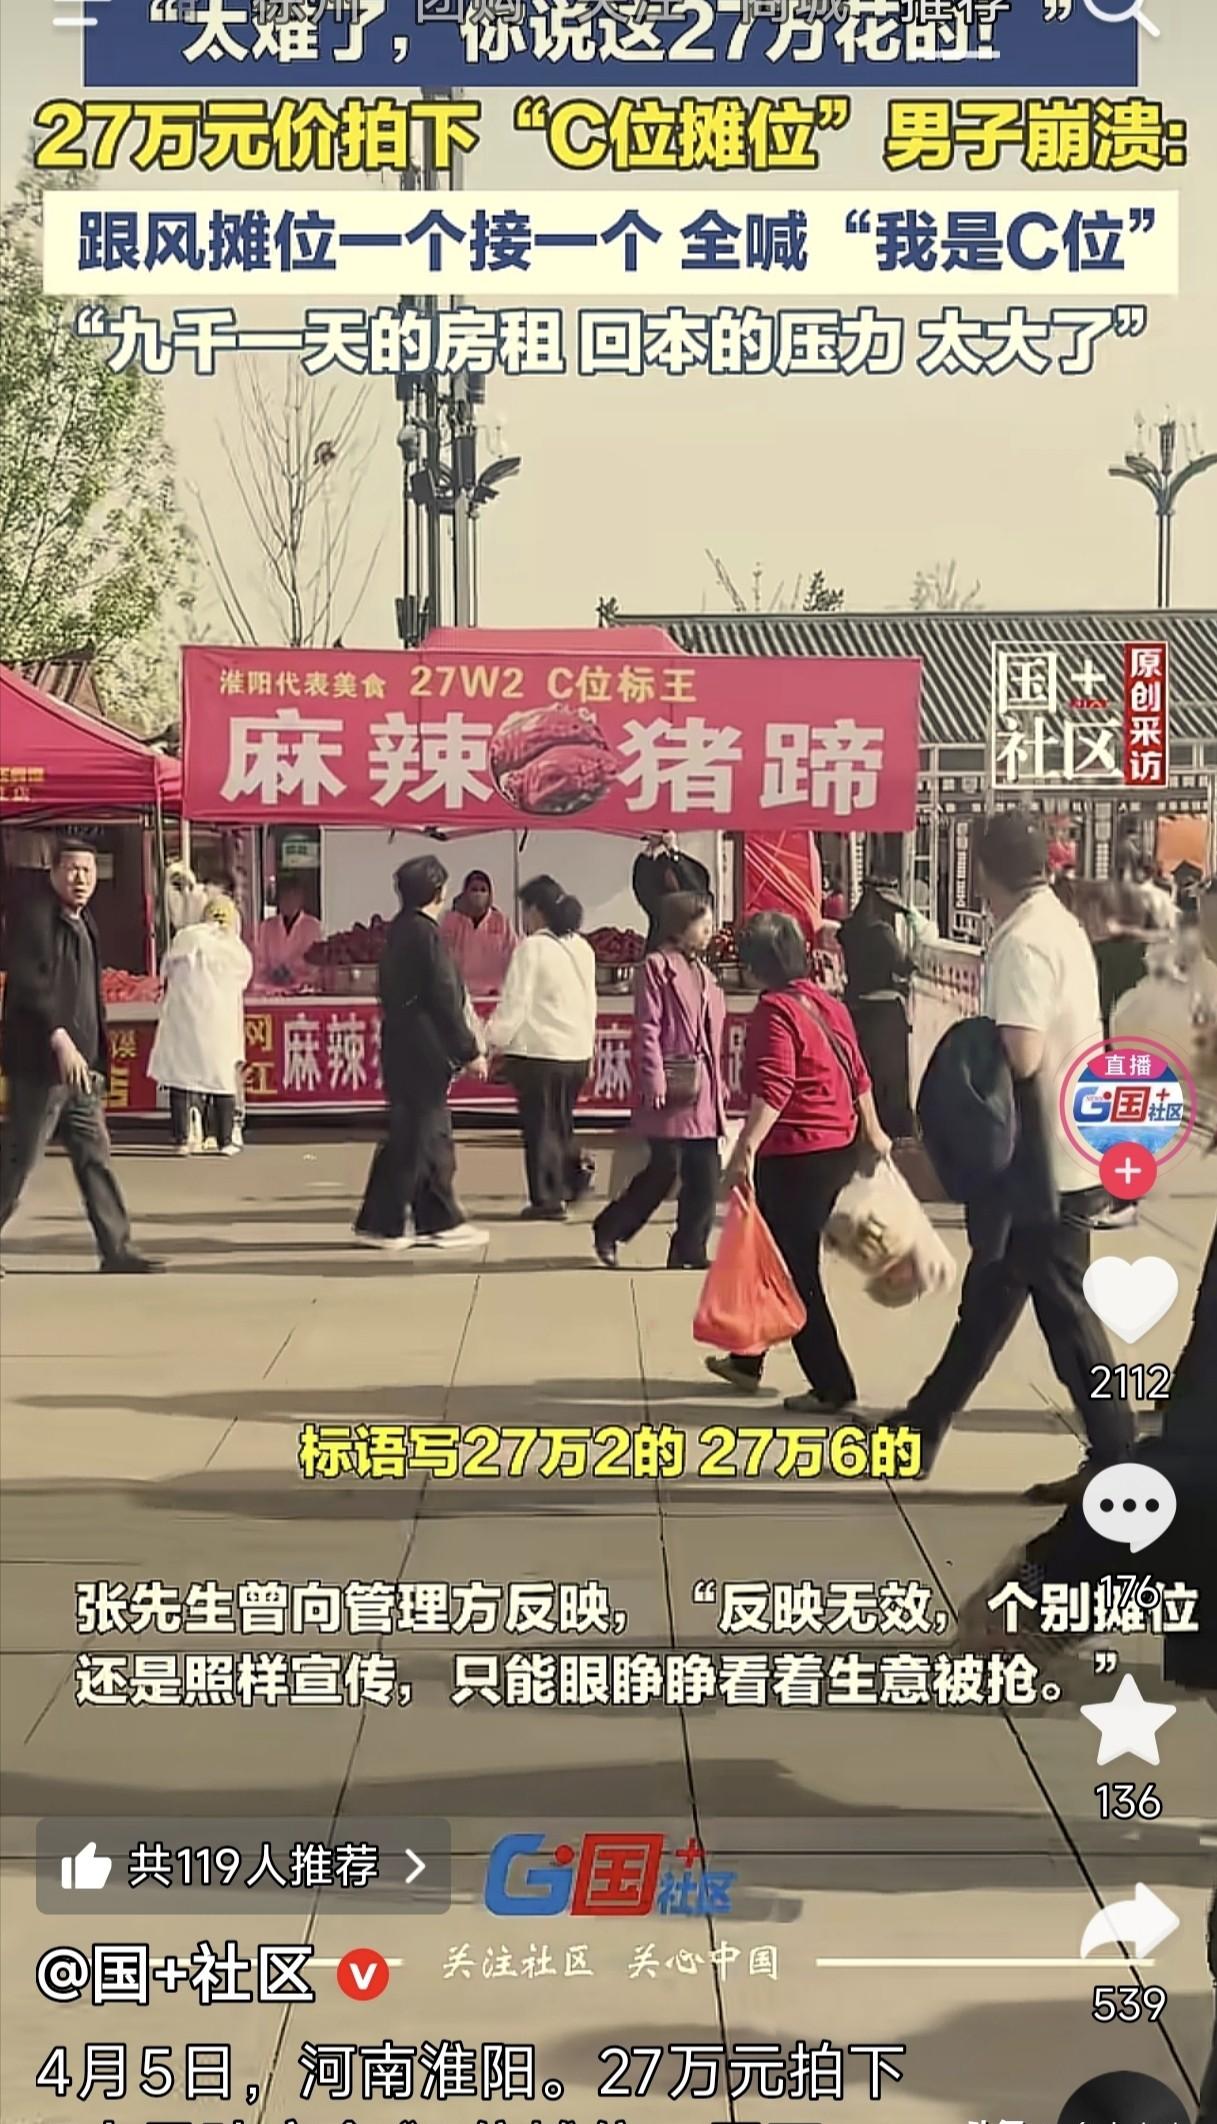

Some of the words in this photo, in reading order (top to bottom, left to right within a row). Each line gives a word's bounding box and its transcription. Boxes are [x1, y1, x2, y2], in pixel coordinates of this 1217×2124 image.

[409, 665, 525, 699] 27W2
[547, 664, 697, 703] C位标王
[219, 707, 494, 809] 麻辣
[616, 716, 885, 816] 猪蹄
[282, 1012, 383, 1092] 麻辣
